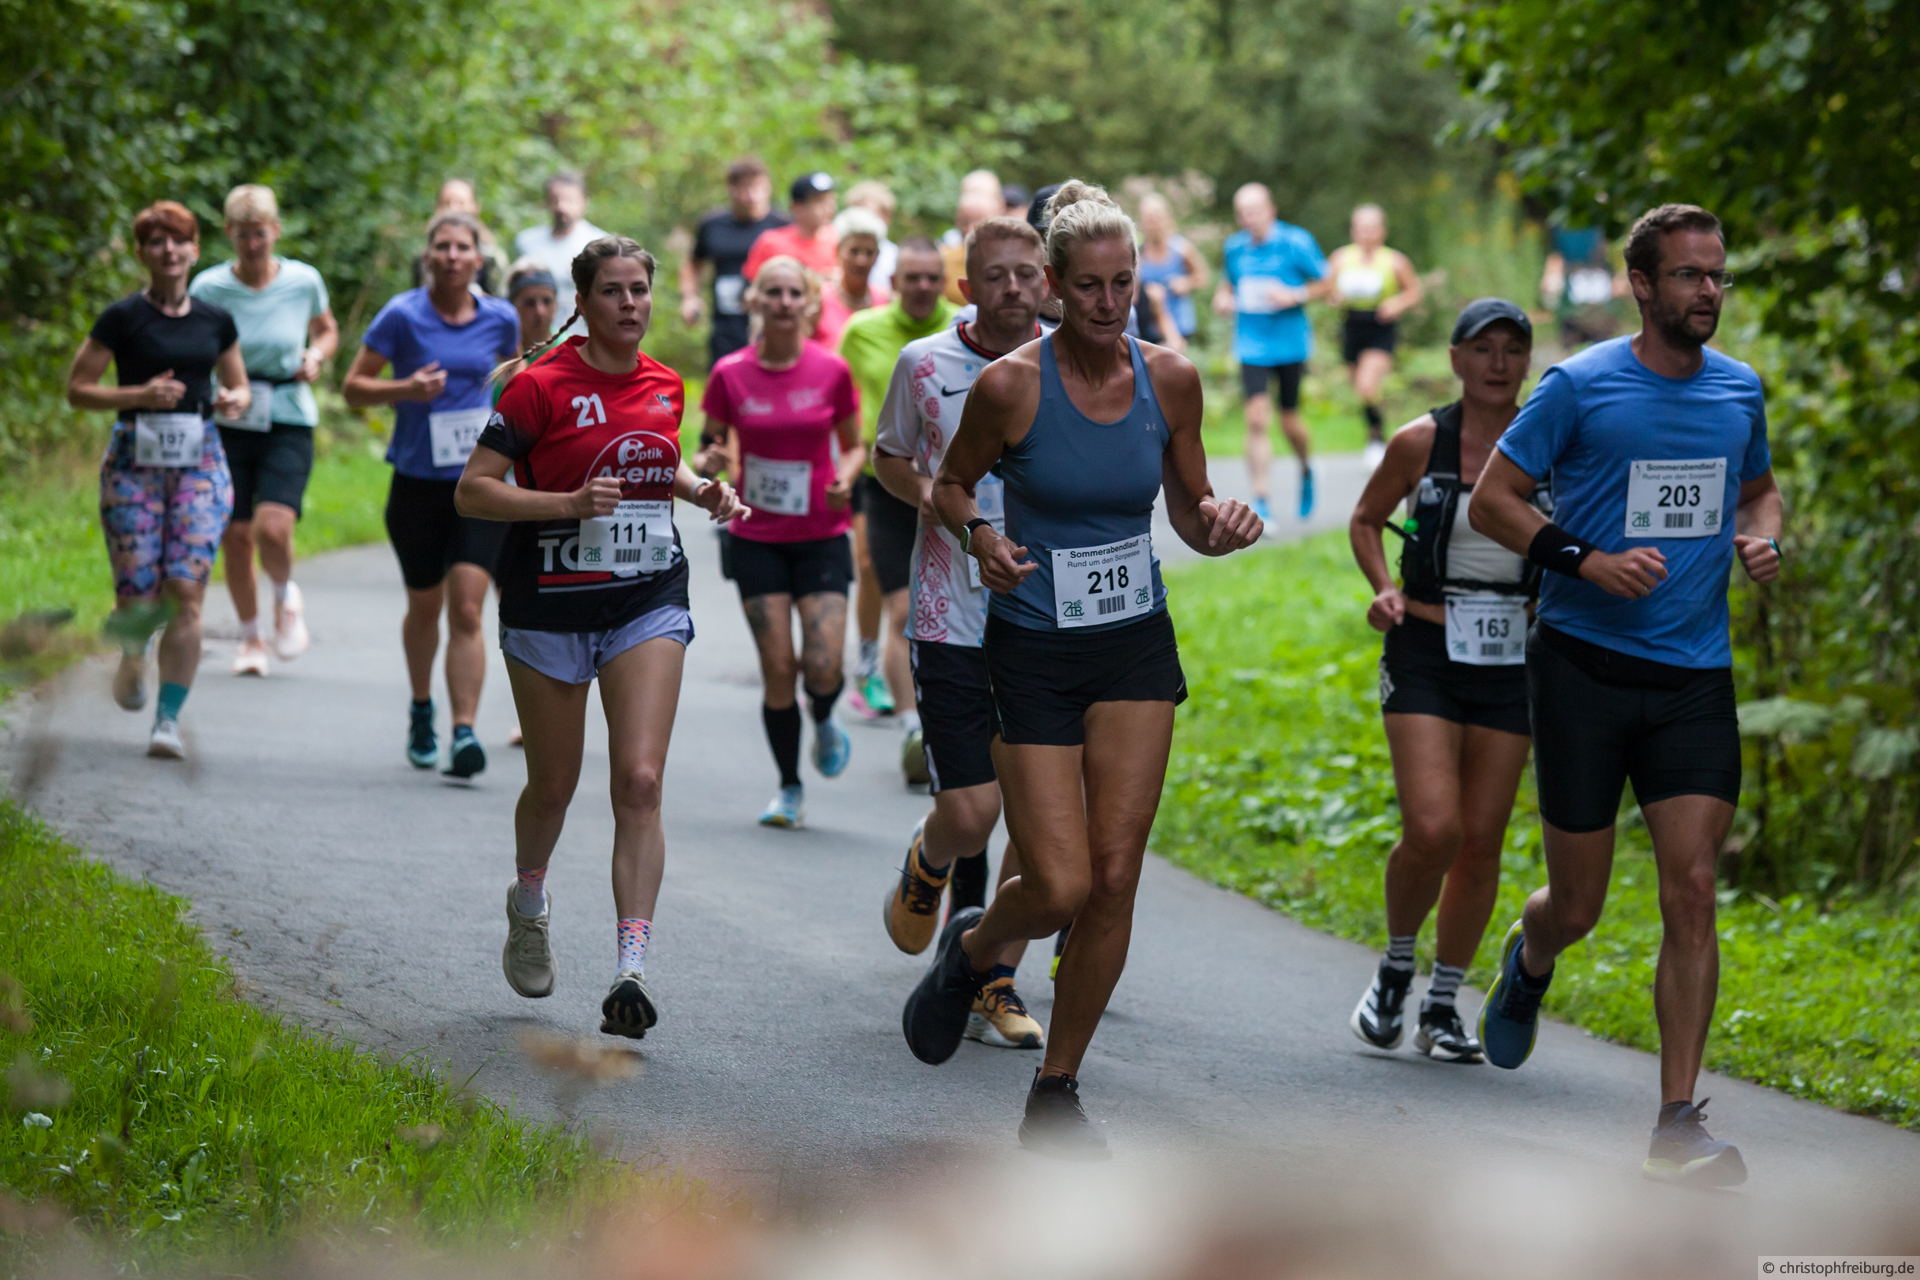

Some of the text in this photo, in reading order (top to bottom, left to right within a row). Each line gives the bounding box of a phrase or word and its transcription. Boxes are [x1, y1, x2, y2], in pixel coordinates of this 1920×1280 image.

[571, 393, 607, 428] 21
[618, 438, 663, 462] Optik
[597, 465, 674, 484] Arens
[1646, 462, 1716, 471] Sommerabendlauf
[1657, 484, 1701, 507] 203
[609, 523, 646, 543] 111
[1067, 560, 1087, 568] Rund
[1102, 557, 1114, 565] den
[1115, 549, 1140, 562] Sorpesee
[1070, 539, 1139, 559] Sommerabendlauf
[1087, 565, 1129, 595] 218
[1474, 617, 1510, 638] 163
